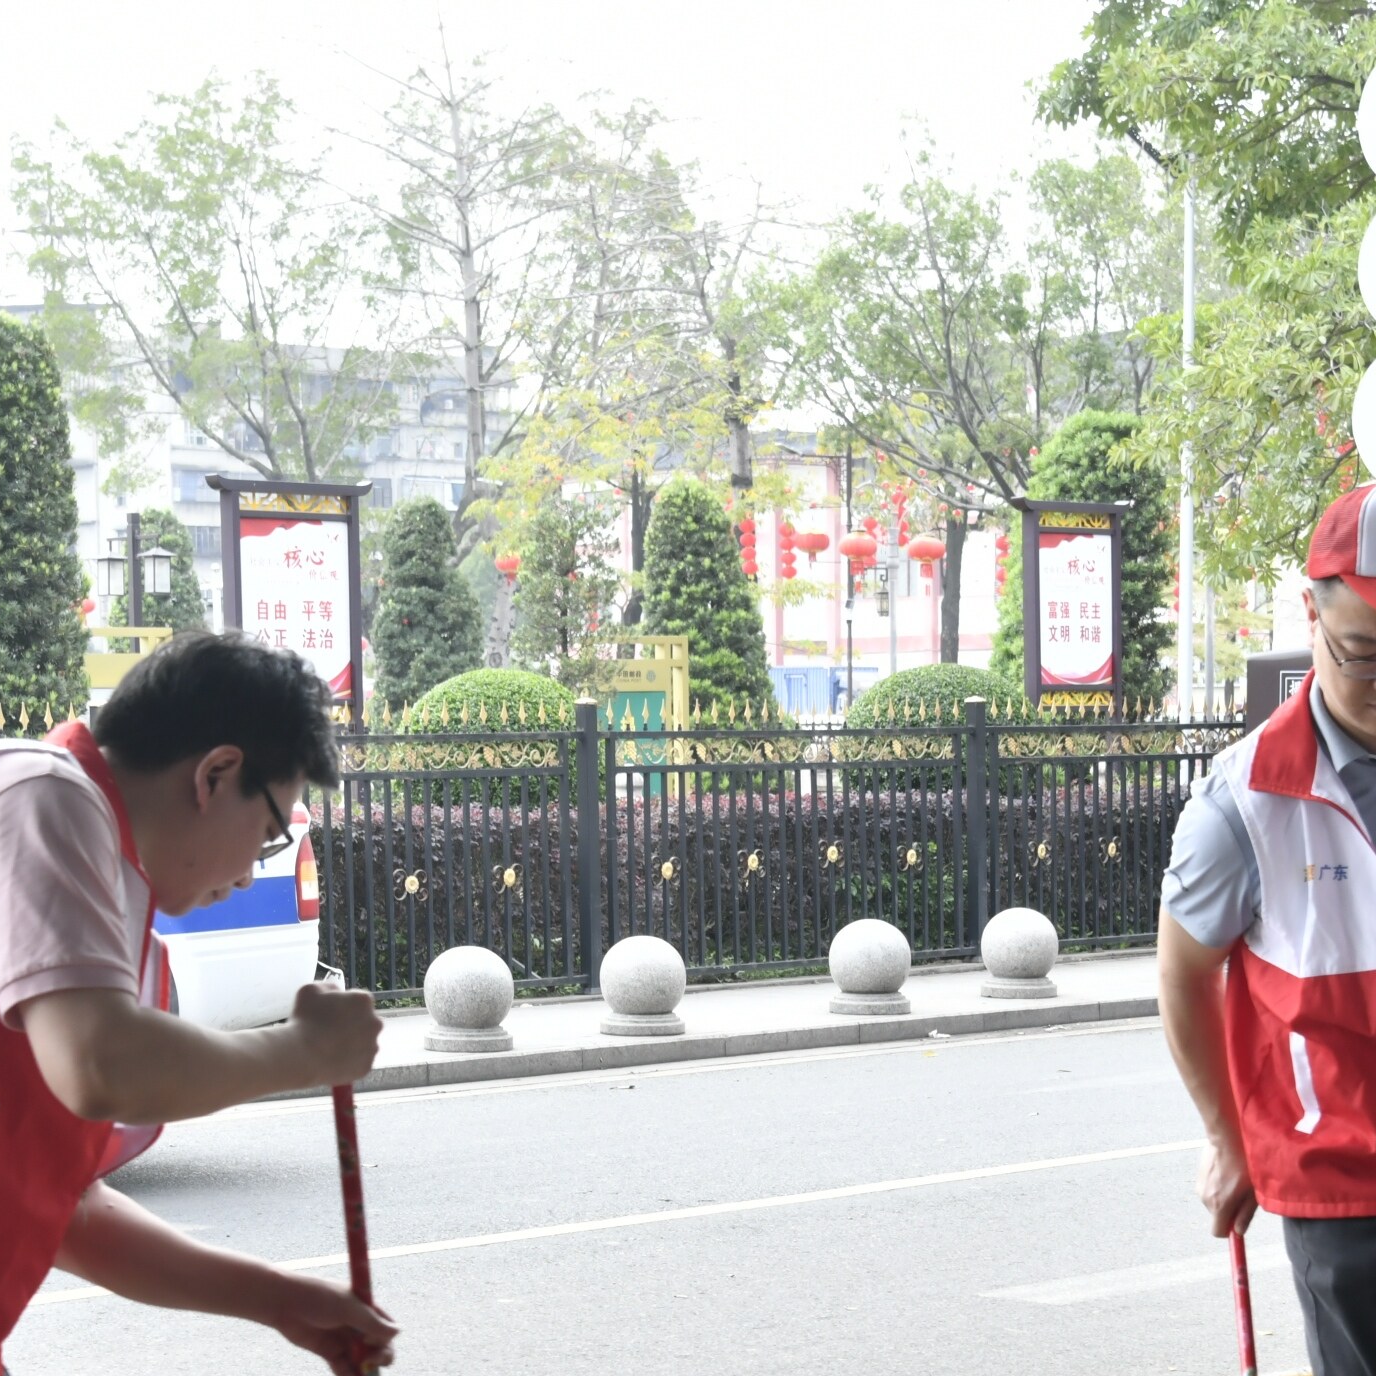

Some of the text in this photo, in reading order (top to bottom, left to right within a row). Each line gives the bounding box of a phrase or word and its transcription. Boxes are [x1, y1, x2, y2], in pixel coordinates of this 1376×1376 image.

[283, 546, 325, 569] 核心
[1067, 555, 1096, 576] 核心
[257, 599, 334, 622] 自由 平等
[1047, 601, 1102, 620] 富强 民主
[256, 628, 334, 649] 公正 法治
[1048, 625, 1102, 643] 文明 和谐
